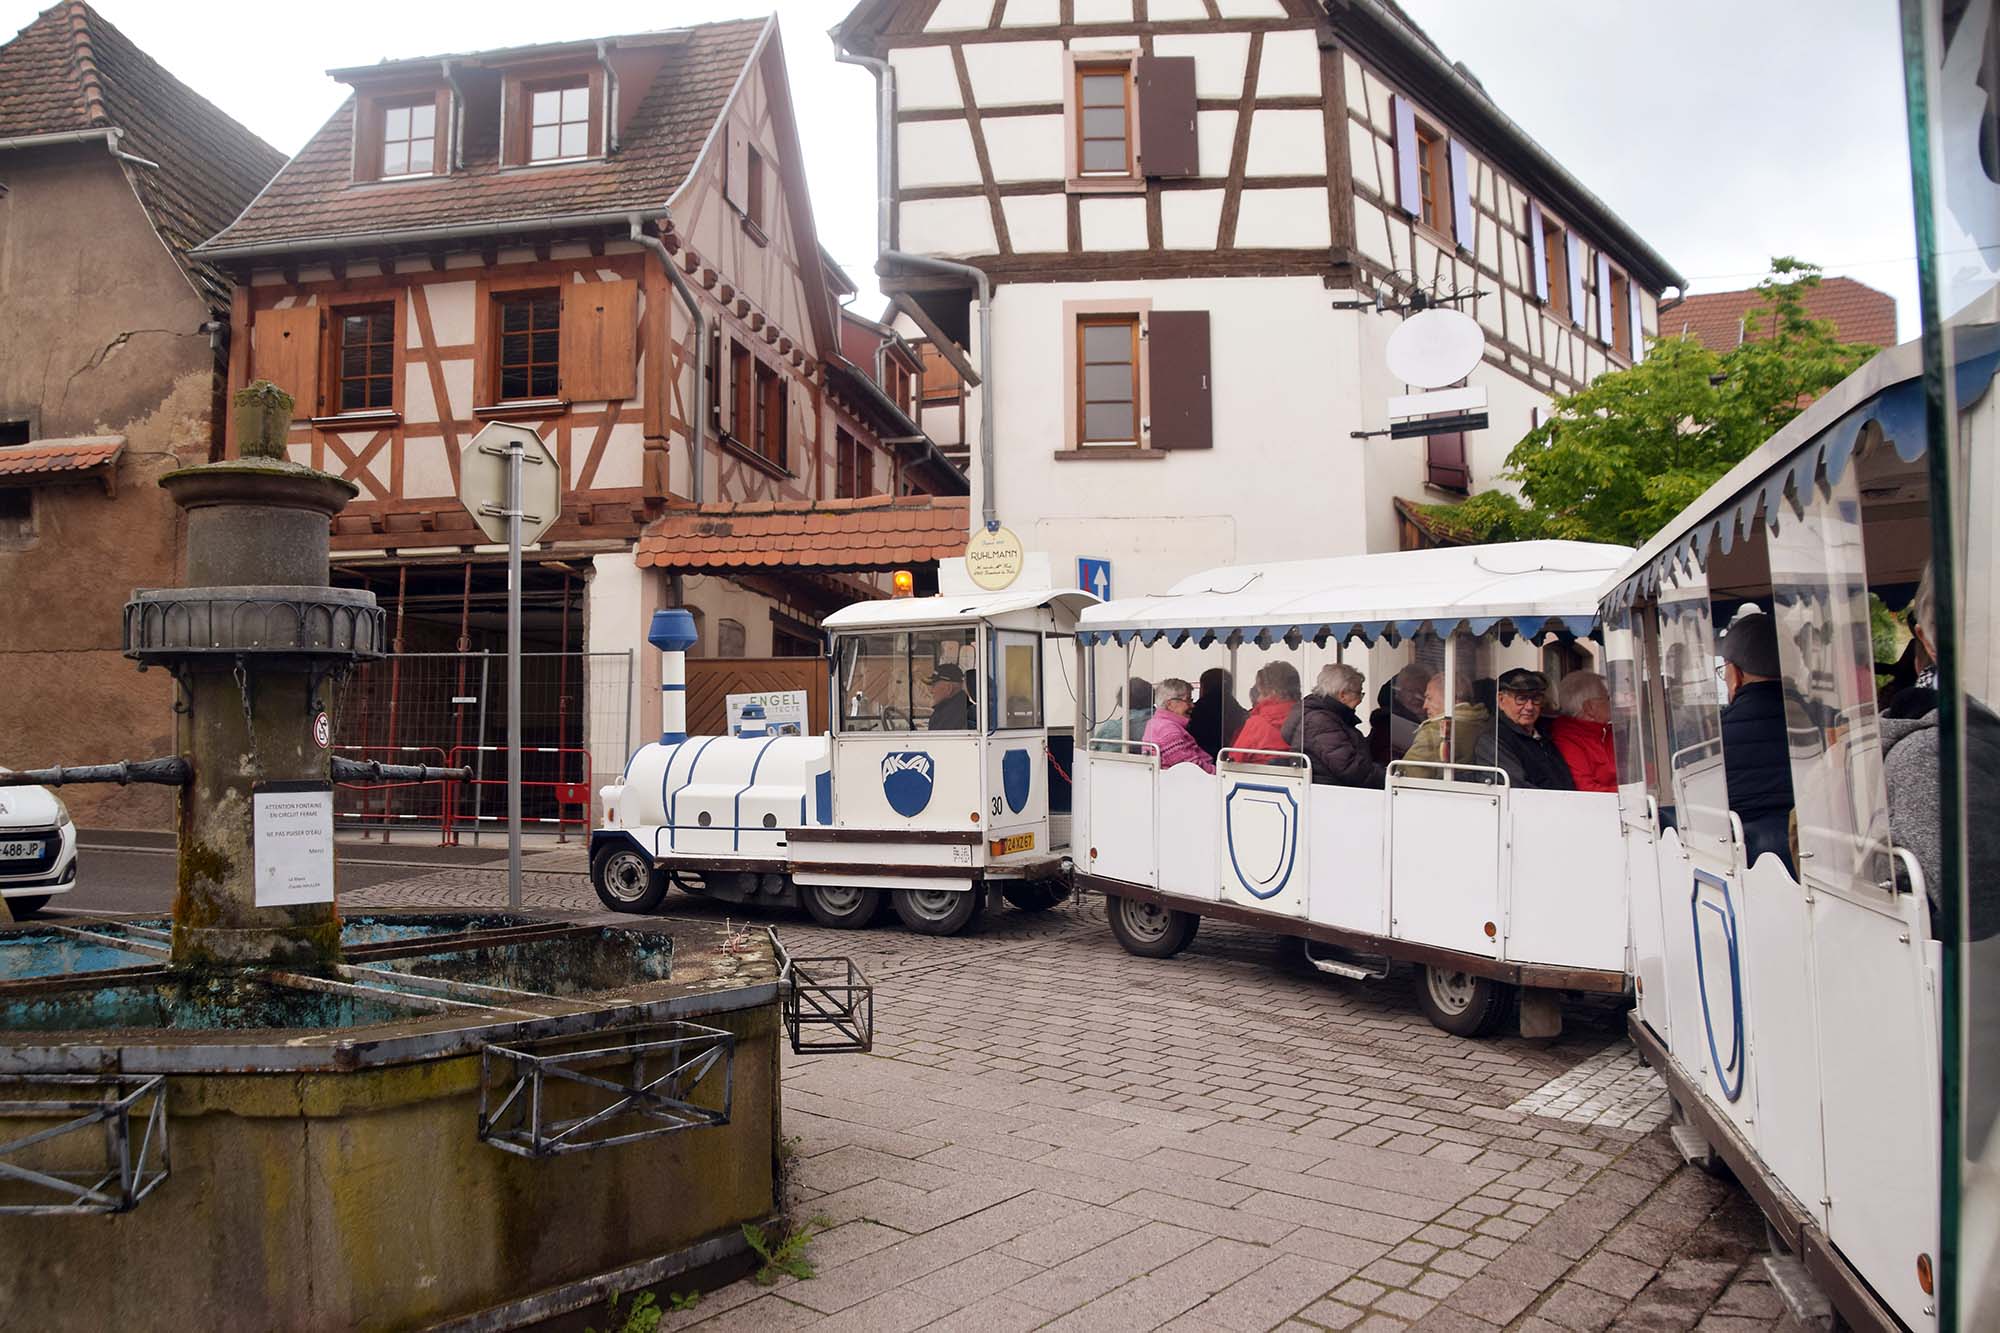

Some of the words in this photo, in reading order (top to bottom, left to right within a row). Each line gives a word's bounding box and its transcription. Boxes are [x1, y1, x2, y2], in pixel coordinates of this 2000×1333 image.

[970, 550, 1017, 560] RUHLMANN
[750, 694, 800, 706] ENGEL
[991, 796, 1002, 816] 30
